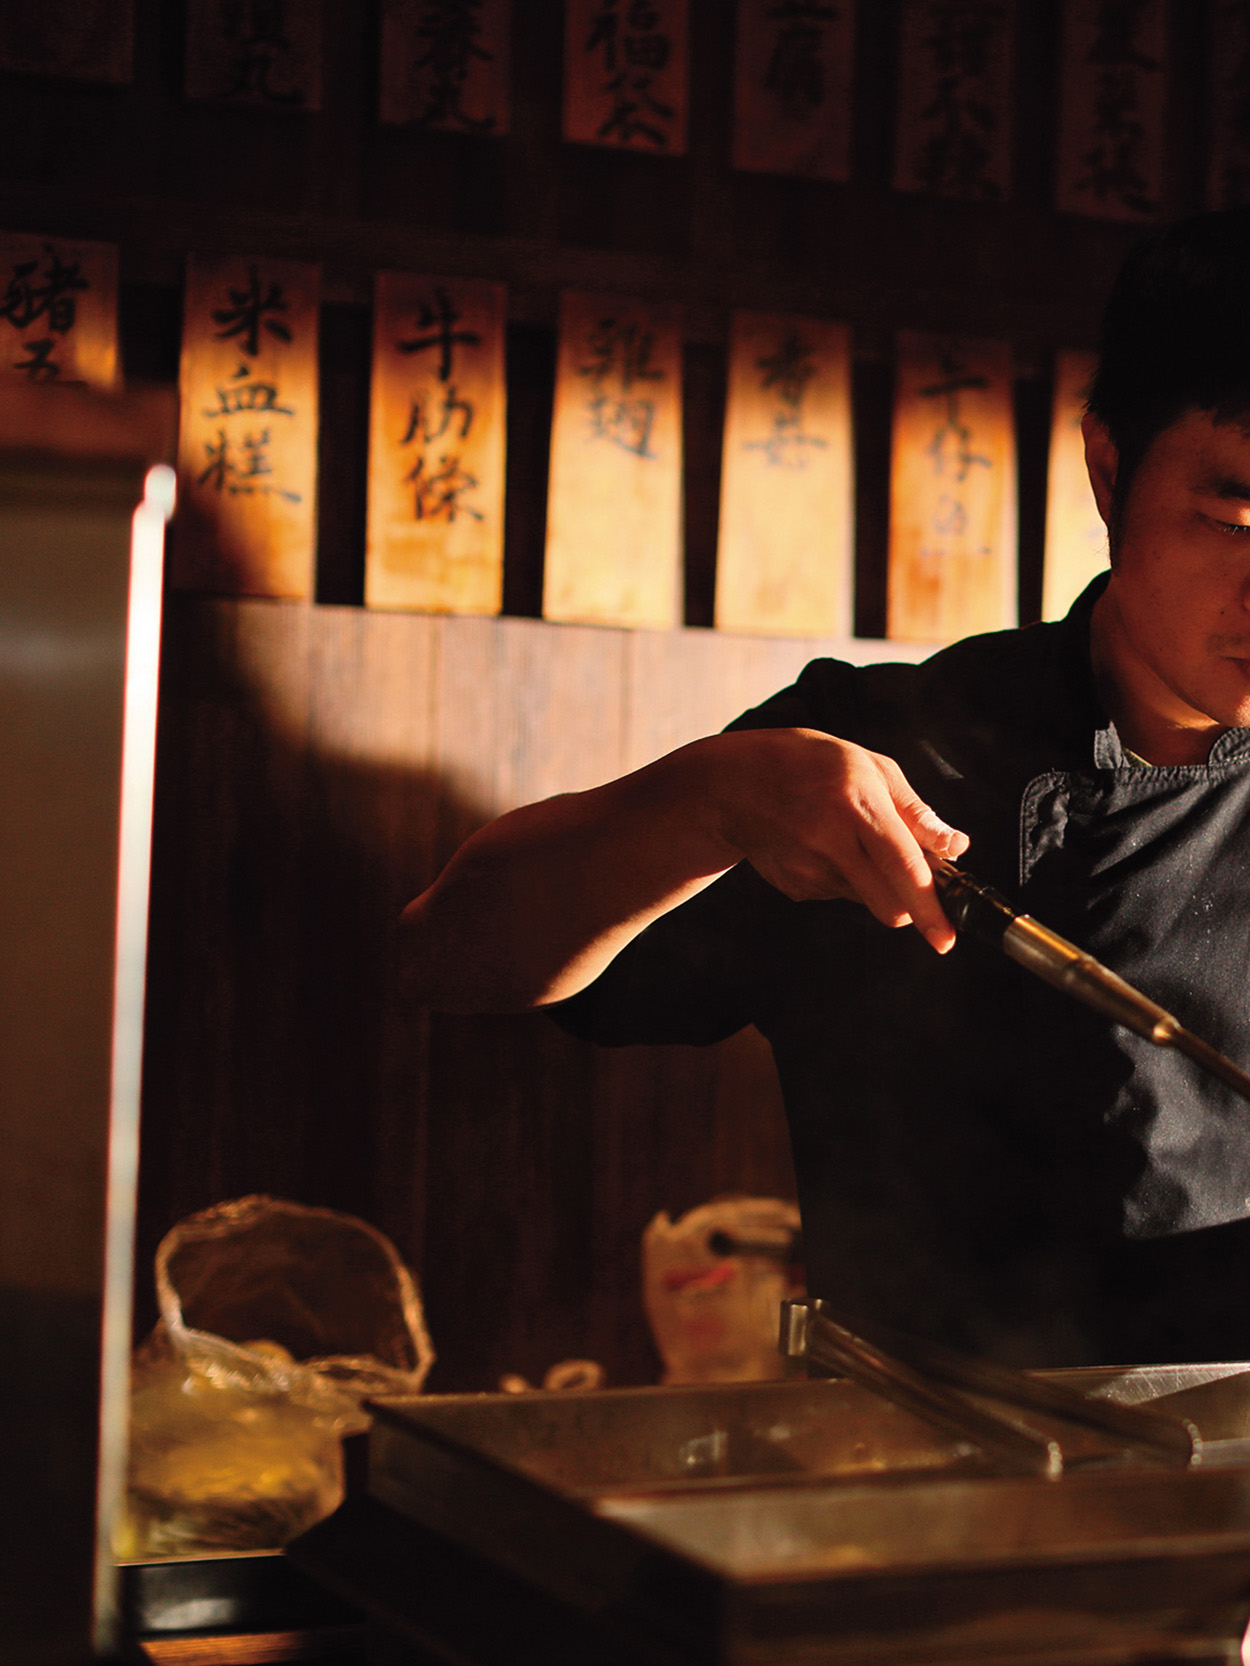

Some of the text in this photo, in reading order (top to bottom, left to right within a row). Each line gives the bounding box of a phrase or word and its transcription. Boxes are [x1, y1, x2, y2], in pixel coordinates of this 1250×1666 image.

[200, 265, 302, 503] 米血糕
[398, 288, 485, 523] 牛肋條
